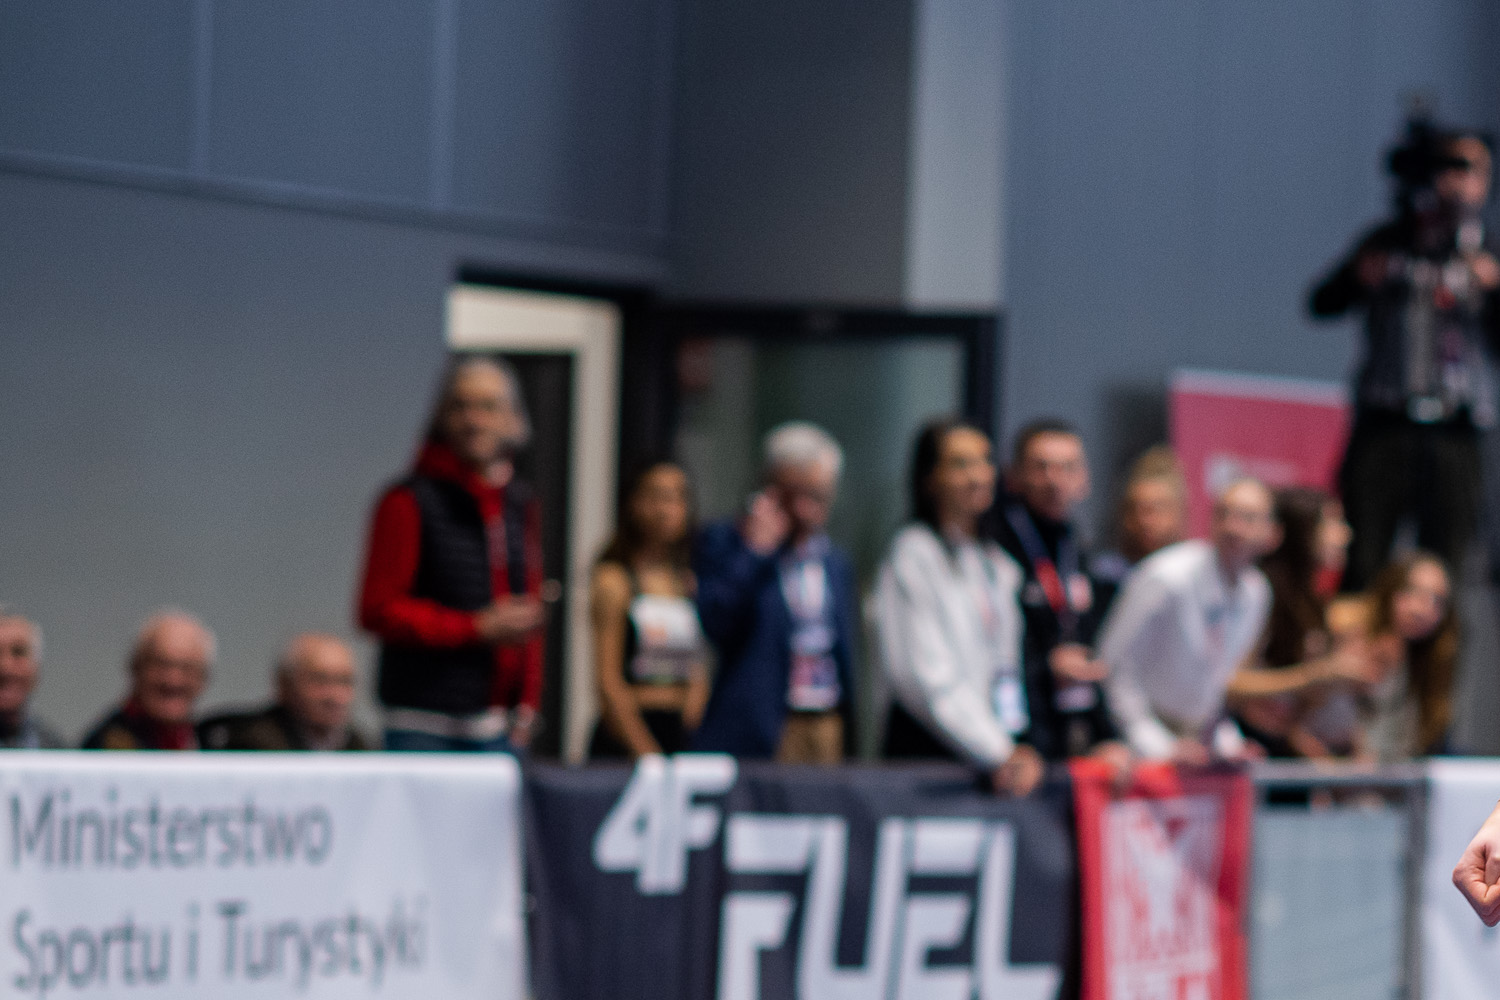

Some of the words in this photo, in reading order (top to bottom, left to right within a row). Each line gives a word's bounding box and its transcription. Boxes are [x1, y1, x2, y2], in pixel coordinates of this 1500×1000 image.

[8, 786, 334, 868] Ministerstwo
[592, 753, 738, 894] 4F
[186, 904, 199, 978] i
[217, 896, 424, 990] Turystyki
